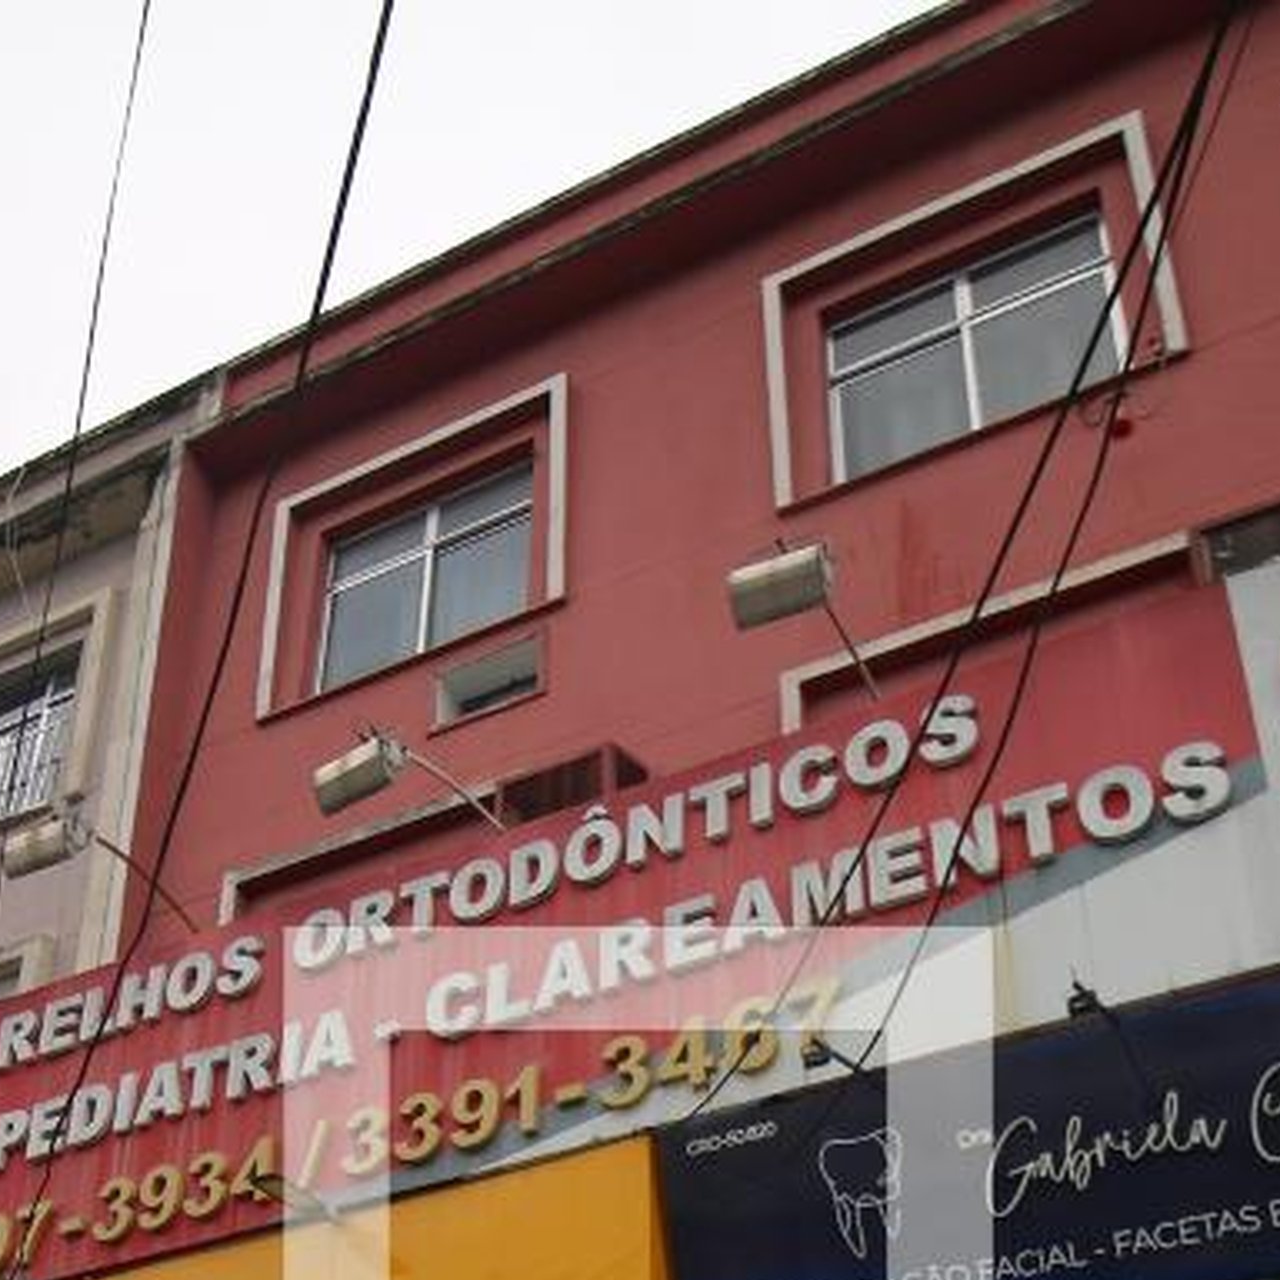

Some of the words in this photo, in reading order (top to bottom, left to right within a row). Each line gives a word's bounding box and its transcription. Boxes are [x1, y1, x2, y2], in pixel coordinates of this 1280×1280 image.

[292, 694, 979, 970] ORTODÔNTICOS
[424, 740, 1232, 1038] CLAREAMENTOS
[984, 1091, 1226, 1218] Gabriela
[1113, 1204, 1262, 1258] FACETAS
